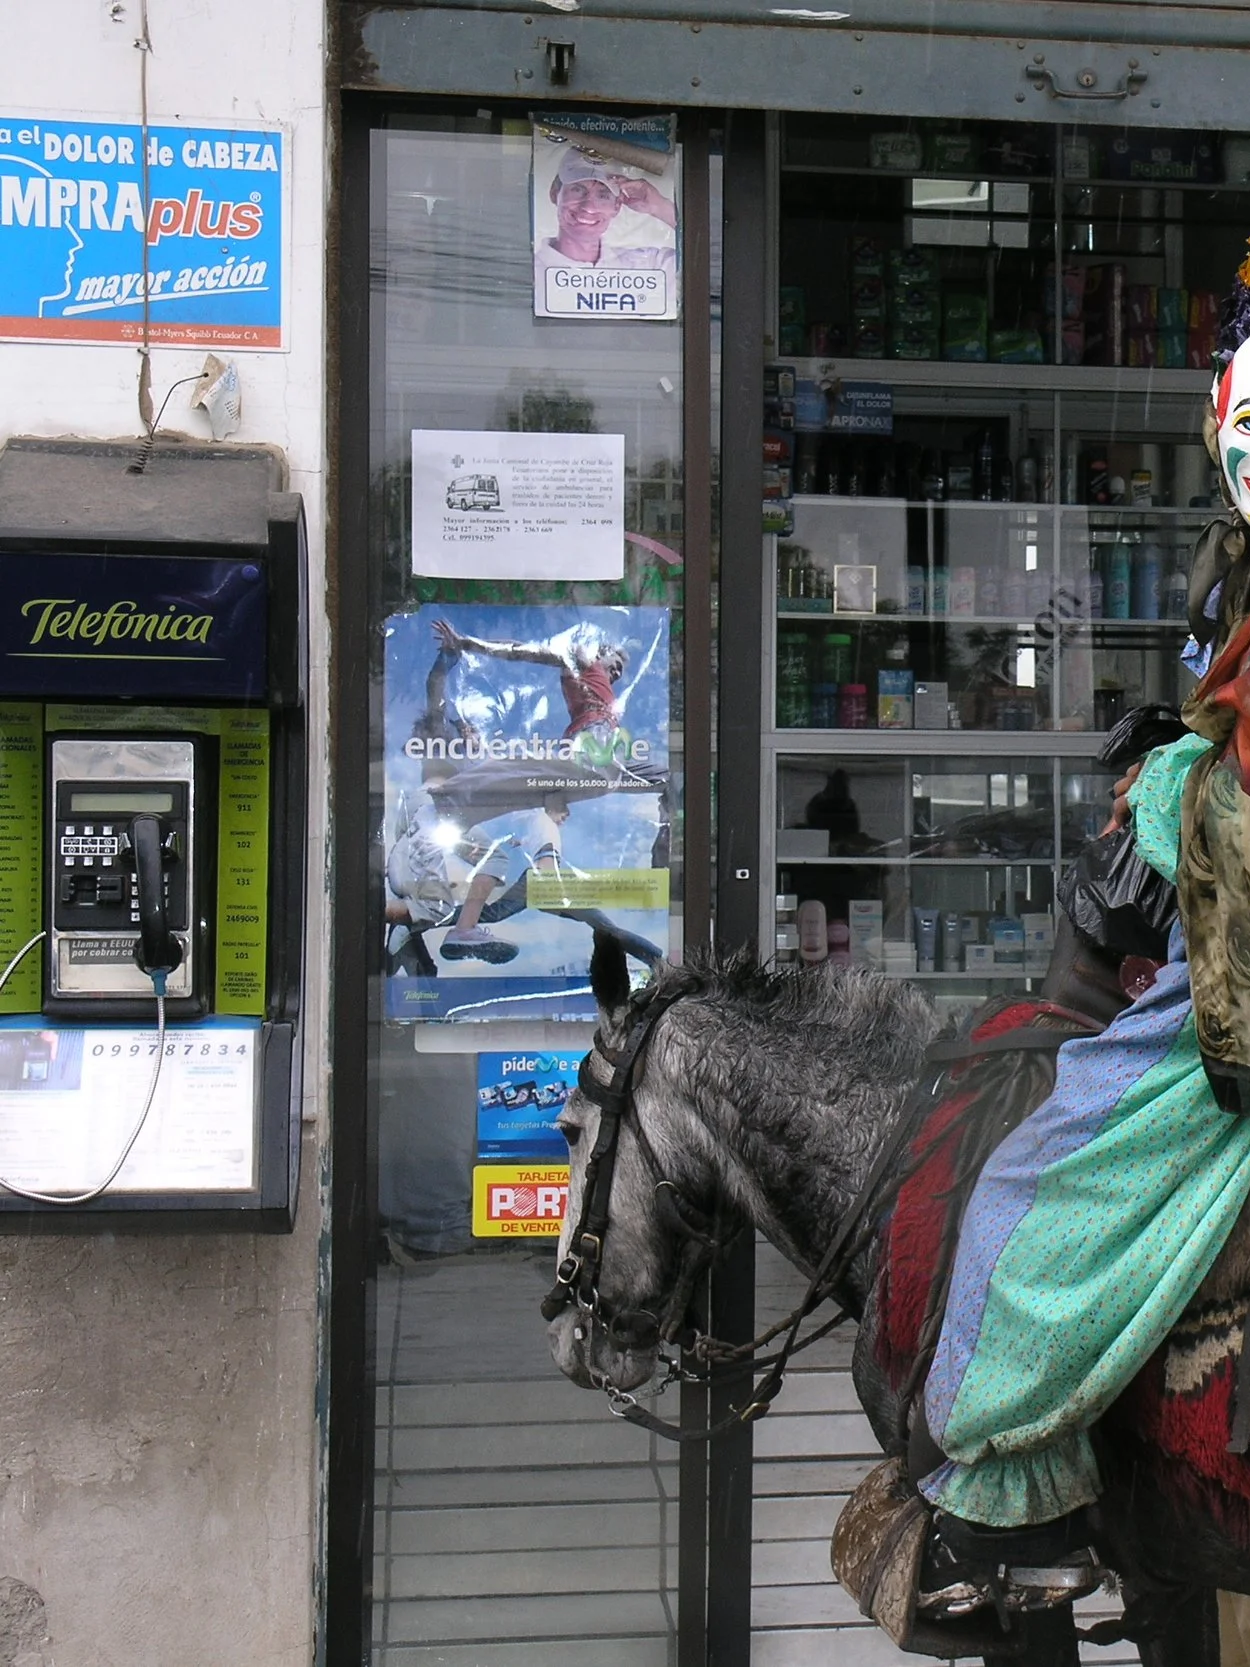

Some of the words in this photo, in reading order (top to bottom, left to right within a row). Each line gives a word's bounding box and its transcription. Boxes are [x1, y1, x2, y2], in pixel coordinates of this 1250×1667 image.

[580, 118, 619, 132] efectivo,
[17, 125, 41, 146] el
[44, 132, 136, 165] DOLOR
[147, 137, 174, 167] de
[181, 140, 279, 172] CABEZA
[147, 188, 264, 247] plus
[75, 268, 172, 306] mayor
[173, 255, 268, 293] acción
[554, 269, 657, 290] Genéricos
[576, 292, 636, 311] NIFA
[527, 778, 537, 788] Sé
[538, 779, 555, 788] uno
[555, 778, 565, 788] de
[566, 778, 578, 788] los
[579, 778, 607, 788] 50.000
[237, 804, 252, 812] 911
[237, 841, 251, 849] 102
[235, 878, 251, 886] 131
[226, 914, 260, 924] 2469009
[72, 940, 99, 949] Llama
[110, 940, 135, 948] EEUU
[71, 950, 87, 959] por
[89, 949, 119, 957] cobrar
[235, 952, 249, 960] 101
[501, 1223, 519, 1233] DE
[521, 1223, 561, 1232] VENTA
